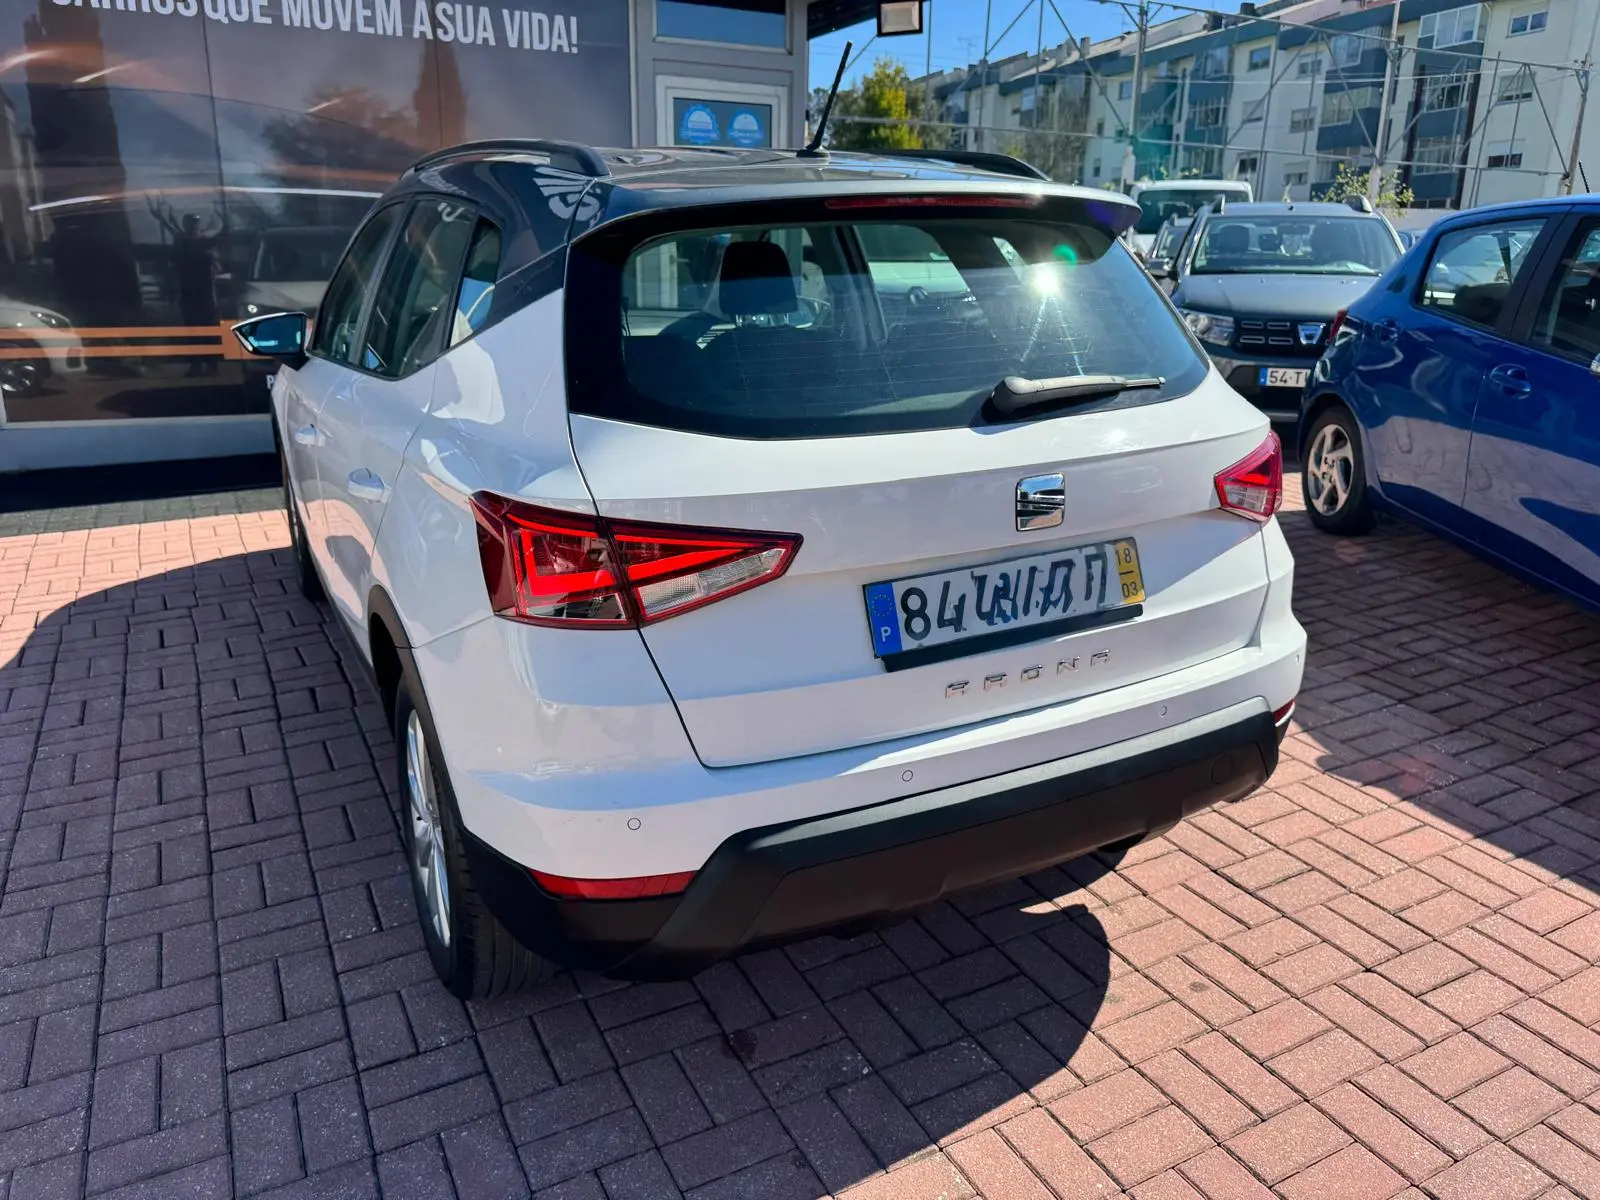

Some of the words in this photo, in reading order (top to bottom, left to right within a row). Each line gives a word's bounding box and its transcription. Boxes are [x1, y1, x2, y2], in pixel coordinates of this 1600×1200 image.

[281, 0, 404, 37] MOVEM
[412, 0, 433, 39] A
[435, 1, 496, 46] SUA
[502, 9, 578, 54] VIDA!
[1115, 547, 1132, 566] 18
[1121, 581, 1139, 598] 03
[880, 625, 892, 642] P
[945, 648, 1111, 699] ARONA
